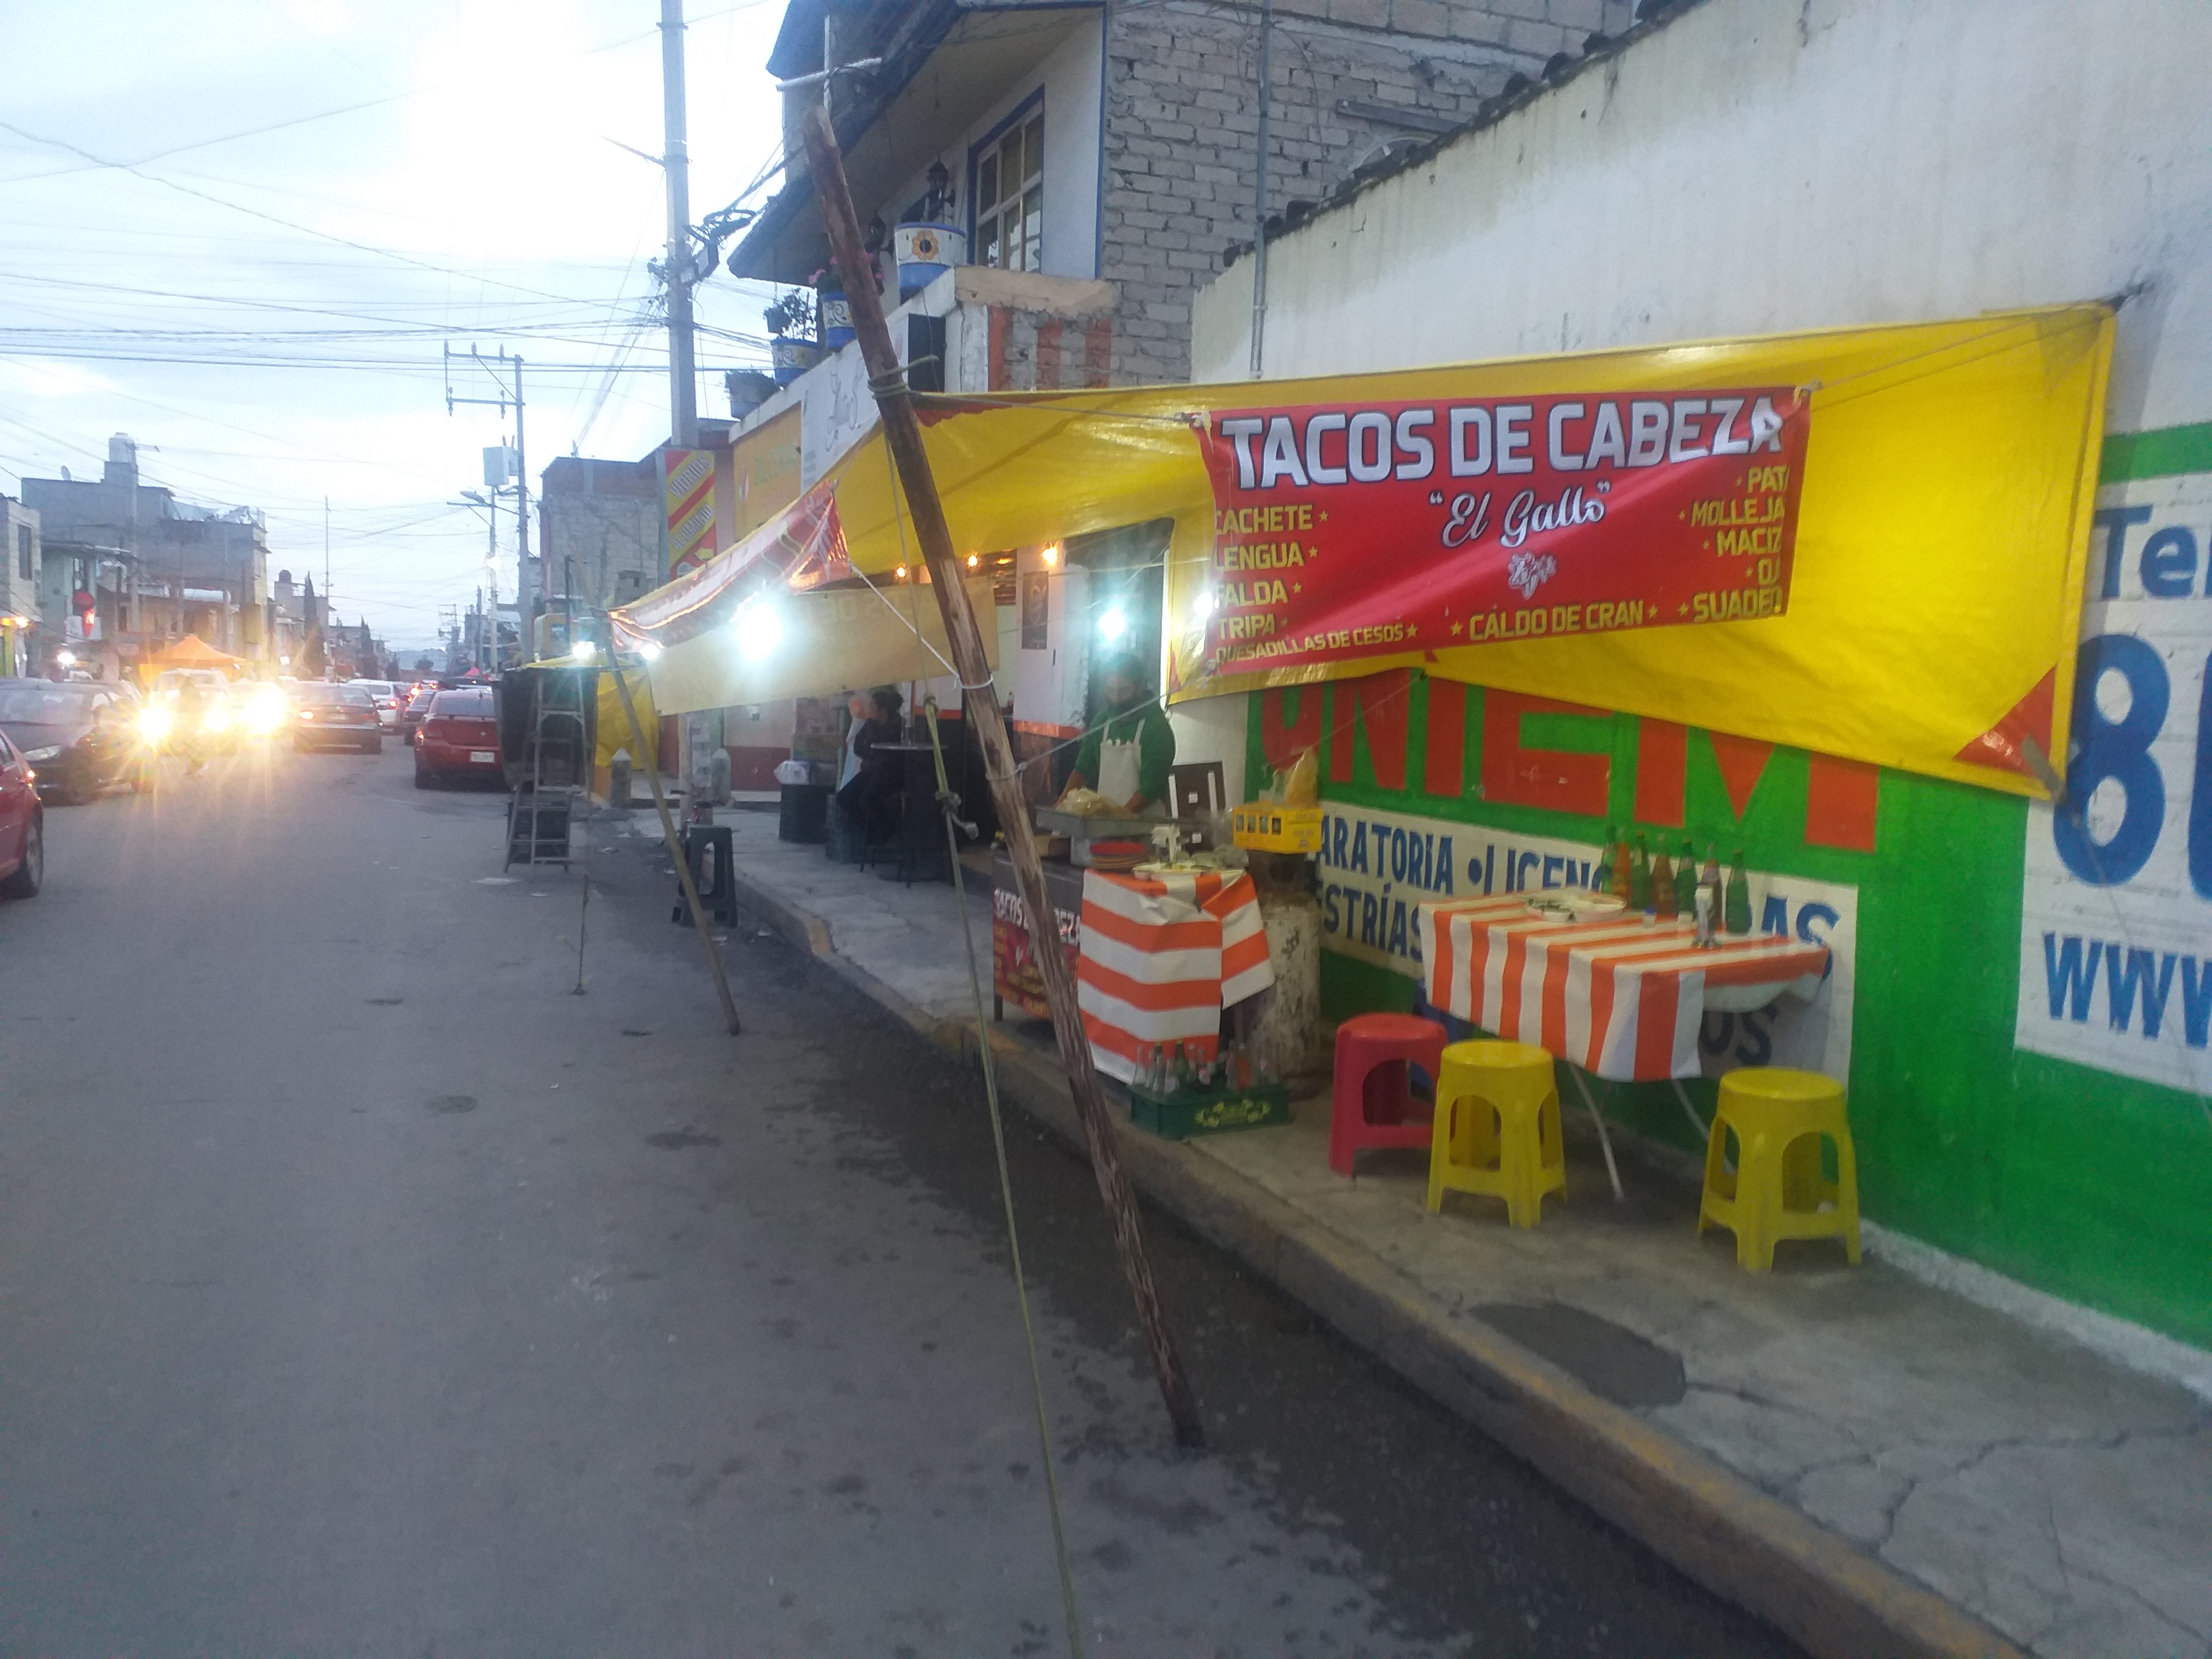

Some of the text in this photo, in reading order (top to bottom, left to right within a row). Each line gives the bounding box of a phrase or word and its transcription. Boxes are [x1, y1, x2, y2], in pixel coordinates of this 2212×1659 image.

[1221, 395, 1784, 490] TACOS DE CABEZA
[669, 454, 713, 499] VIDRIOS
[1747, 465, 1790, 493] PAT
[670, 504, 714, 552] ALUMINIO
[1215, 542, 1305, 571] LENGUA
[1218, 614, 1276, 640] TRIPA
[1328, 629, 1350, 649] DE
[1352, 623, 1404, 646] CESOS
[1469, 600, 1643, 641] CALDO DE CRAN
